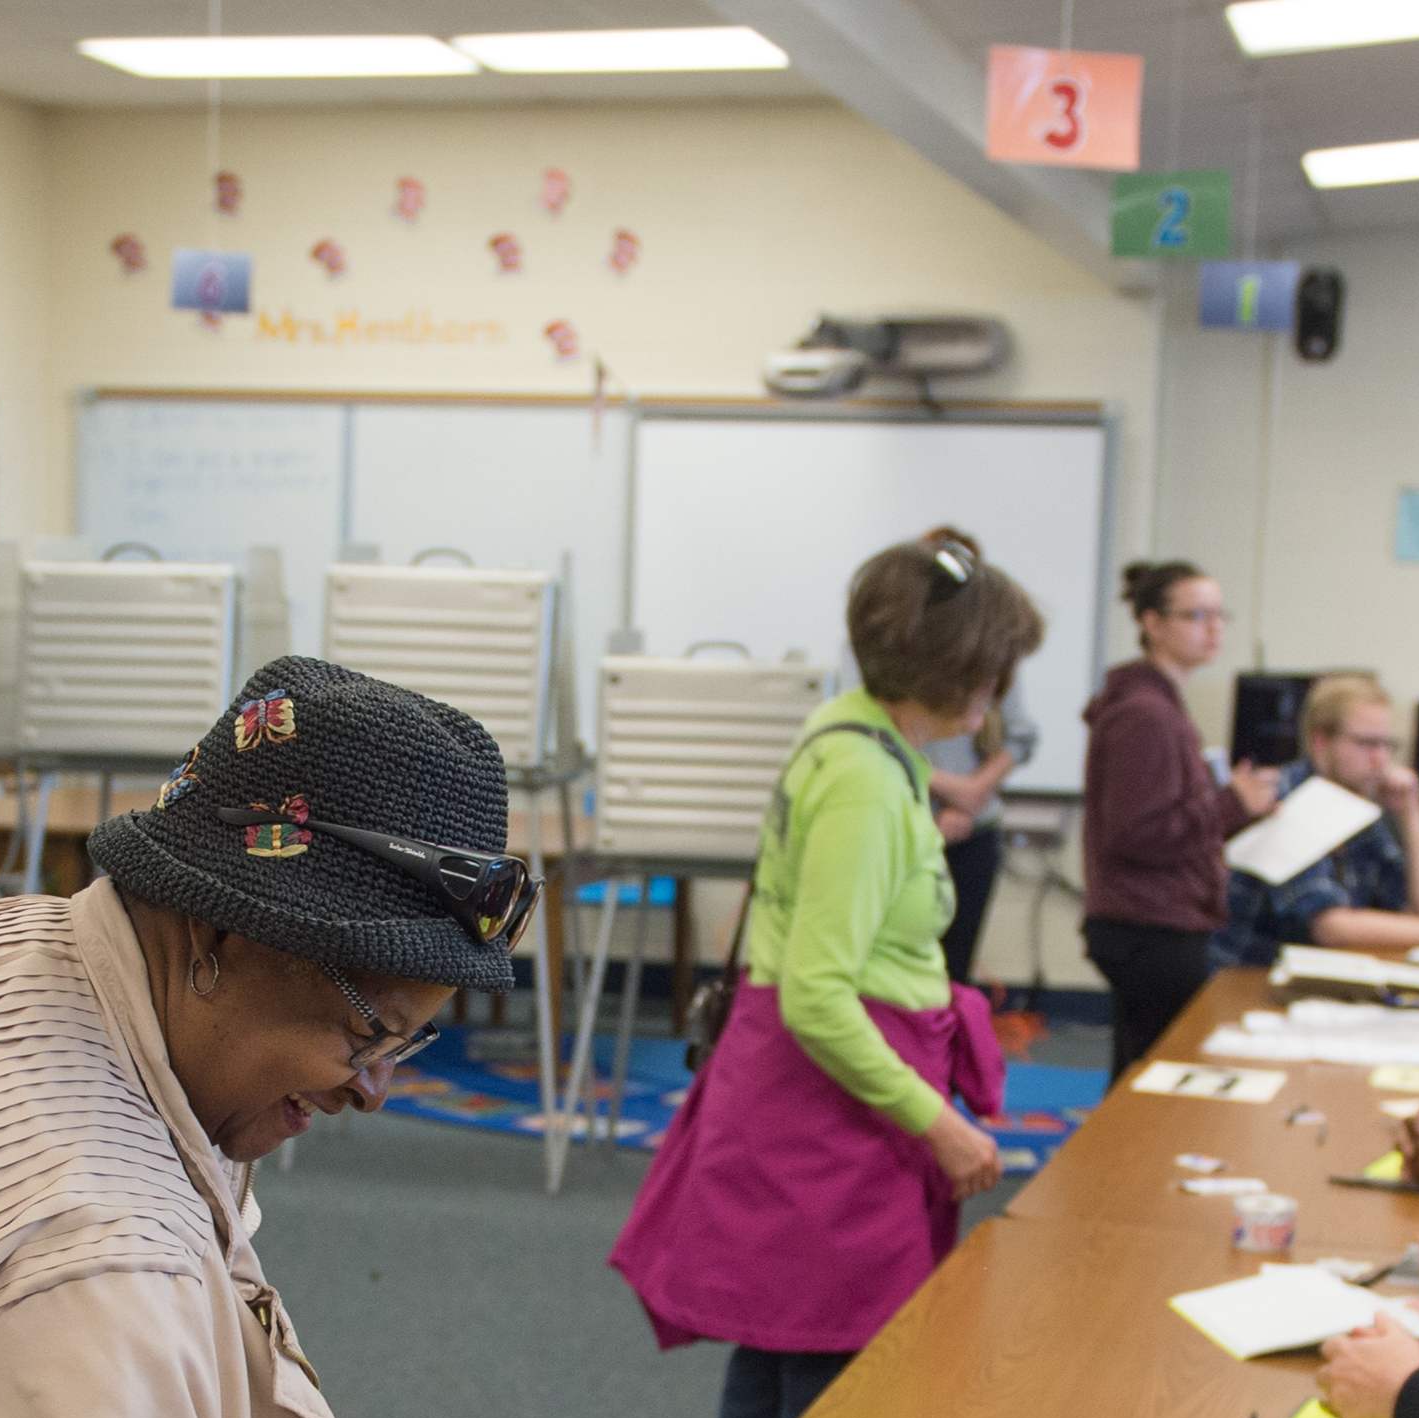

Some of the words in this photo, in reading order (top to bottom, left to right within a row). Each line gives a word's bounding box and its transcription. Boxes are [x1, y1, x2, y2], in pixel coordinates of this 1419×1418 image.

[1042, 80, 1086, 150] 3
[1153, 188, 1191, 246] 2
[1240, 280, 1256, 322] 1
